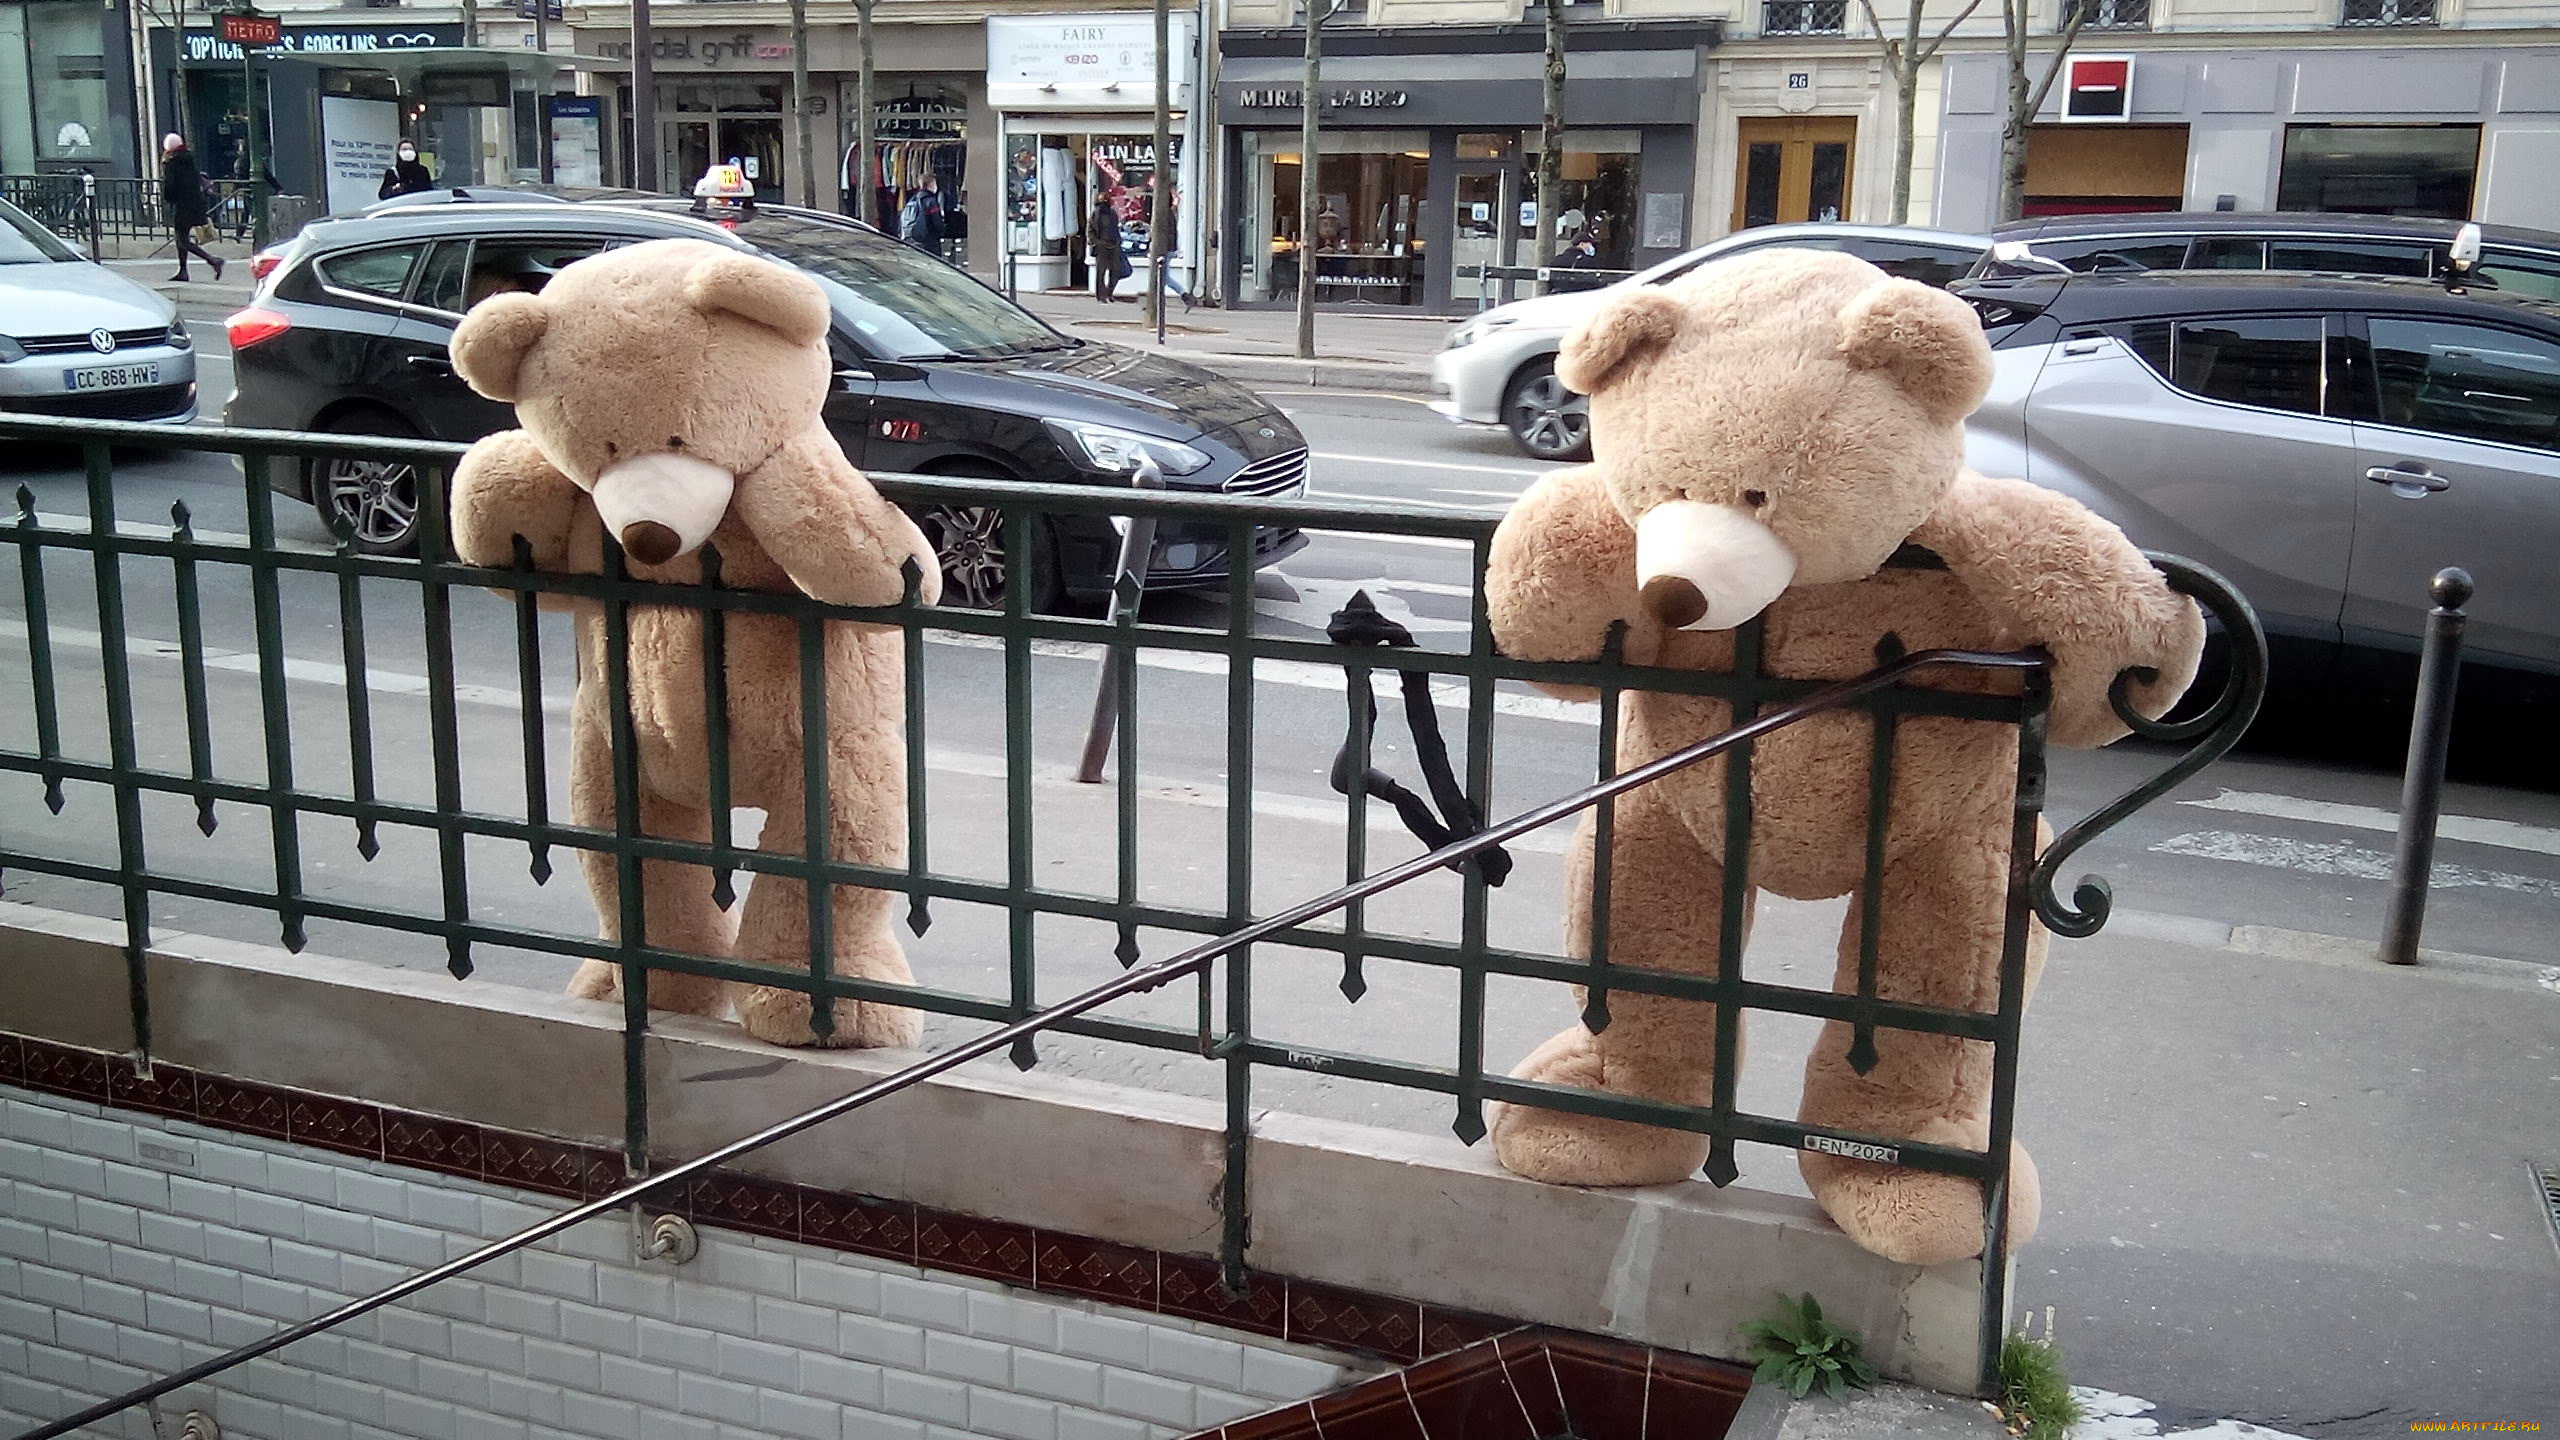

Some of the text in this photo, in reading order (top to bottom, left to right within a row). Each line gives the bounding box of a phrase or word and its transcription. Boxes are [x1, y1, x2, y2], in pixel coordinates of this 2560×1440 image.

[1063, 28, 1106, 41] FAIRY
[598, 35, 695, 60] modial
[1791, 75, 1806, 88] 26
[1099, 145, 1129, 160] LIN
